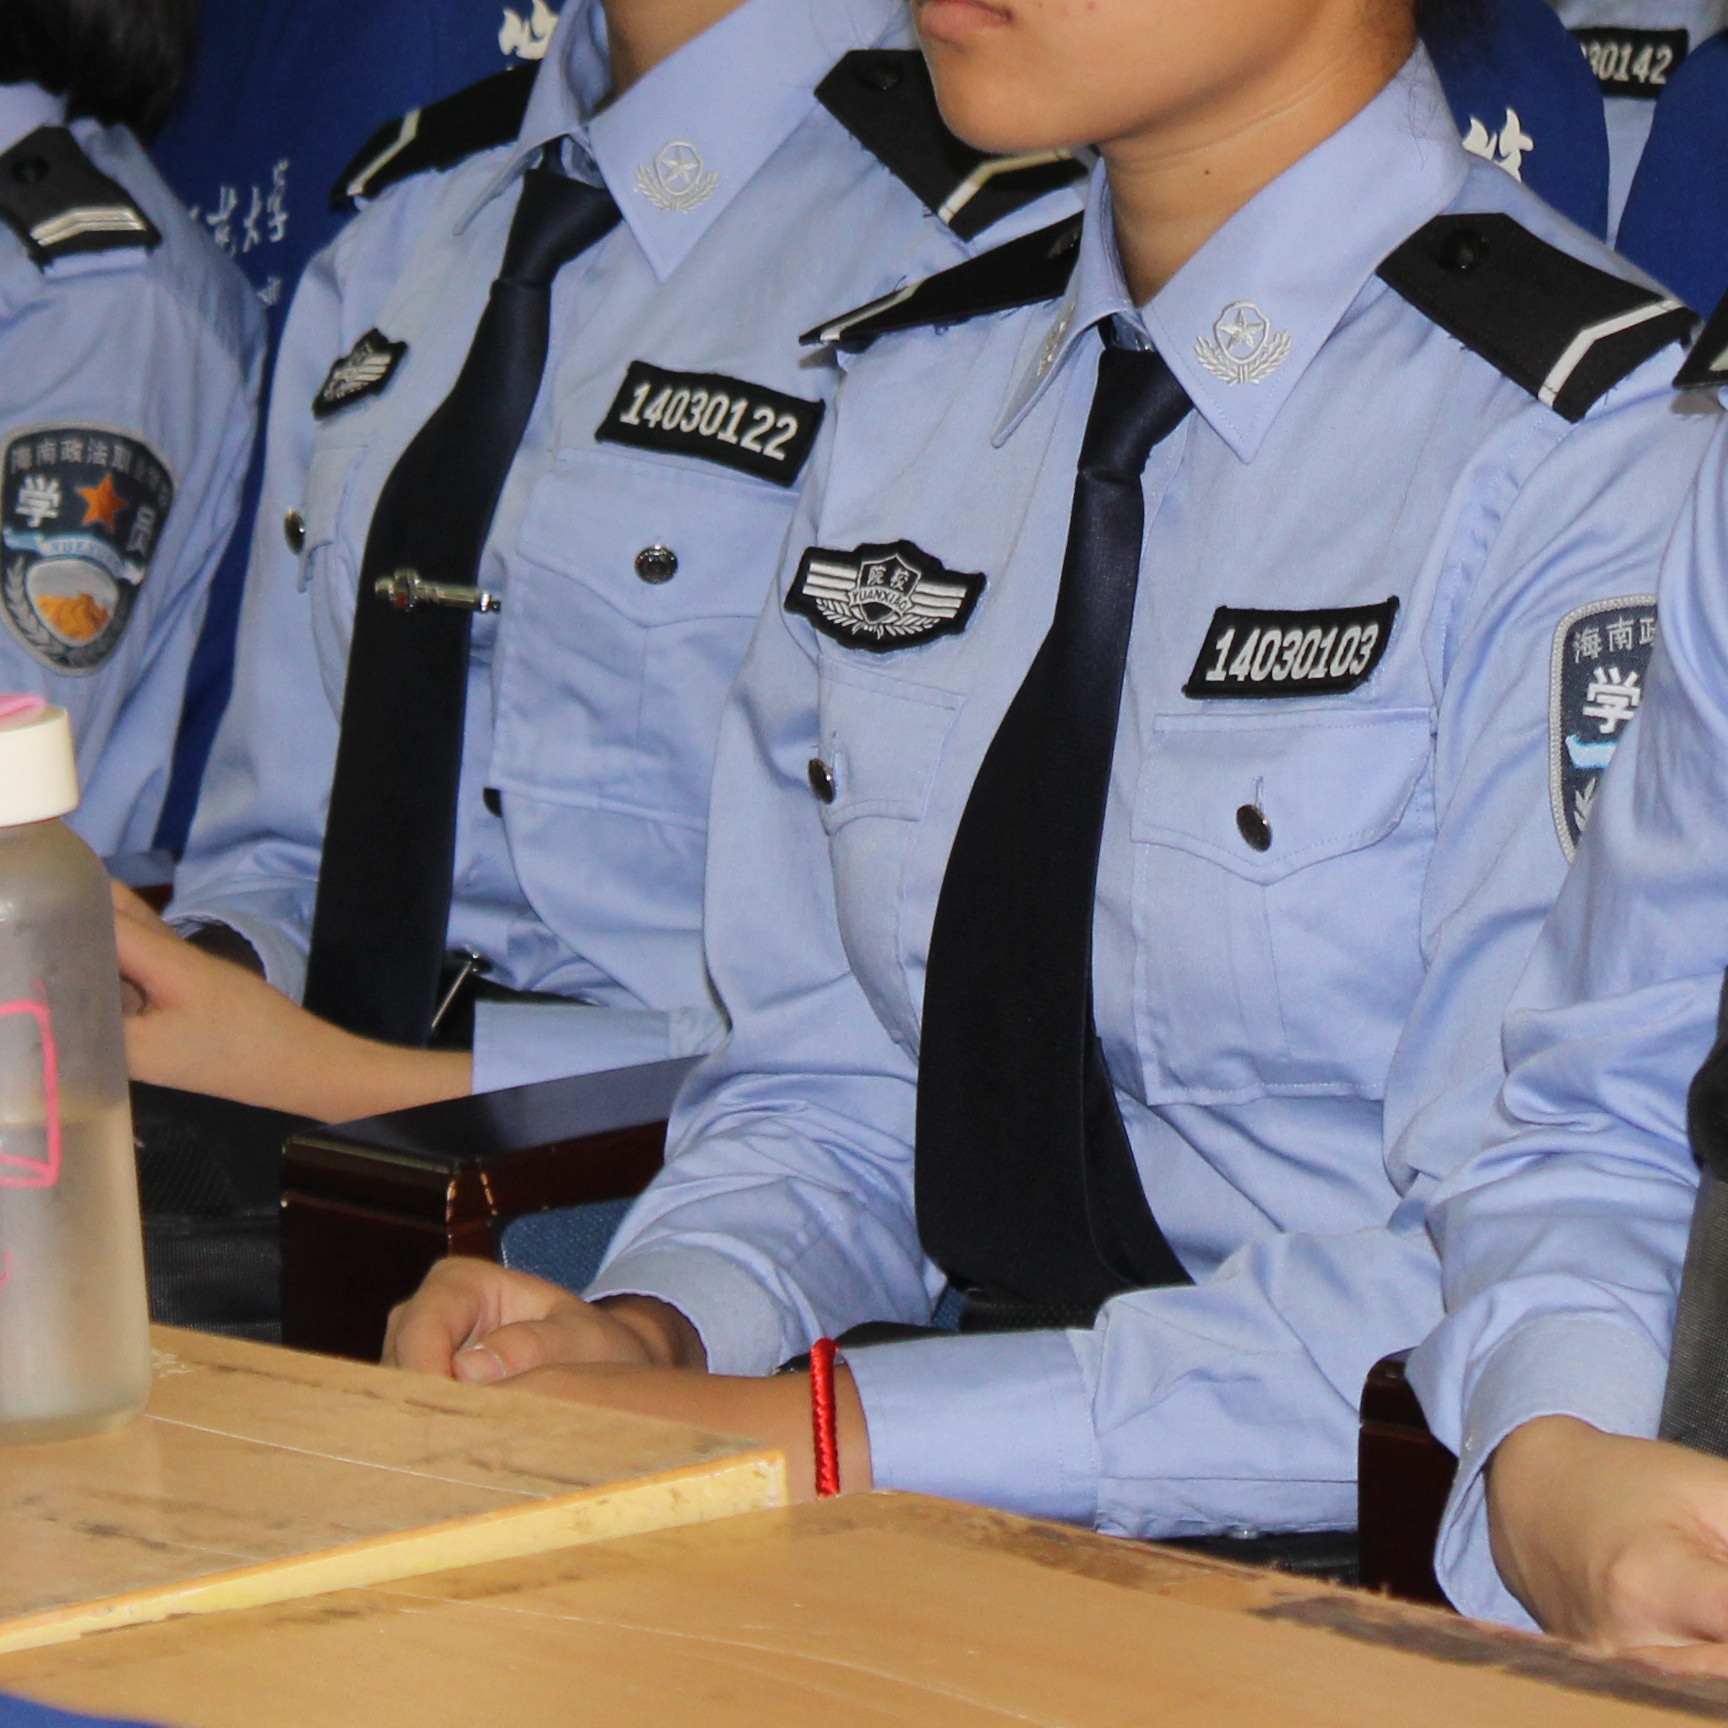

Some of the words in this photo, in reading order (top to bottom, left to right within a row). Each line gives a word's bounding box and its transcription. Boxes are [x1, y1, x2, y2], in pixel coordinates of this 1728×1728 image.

[620, 382, 799, 462] 14030122
[15, 474, 63, 528] 学
[850, 589, 909, 612] YUANXIAO
[1205, 623, 1379, 682] 14030103
[1583, 666, 1642, 734] 学
